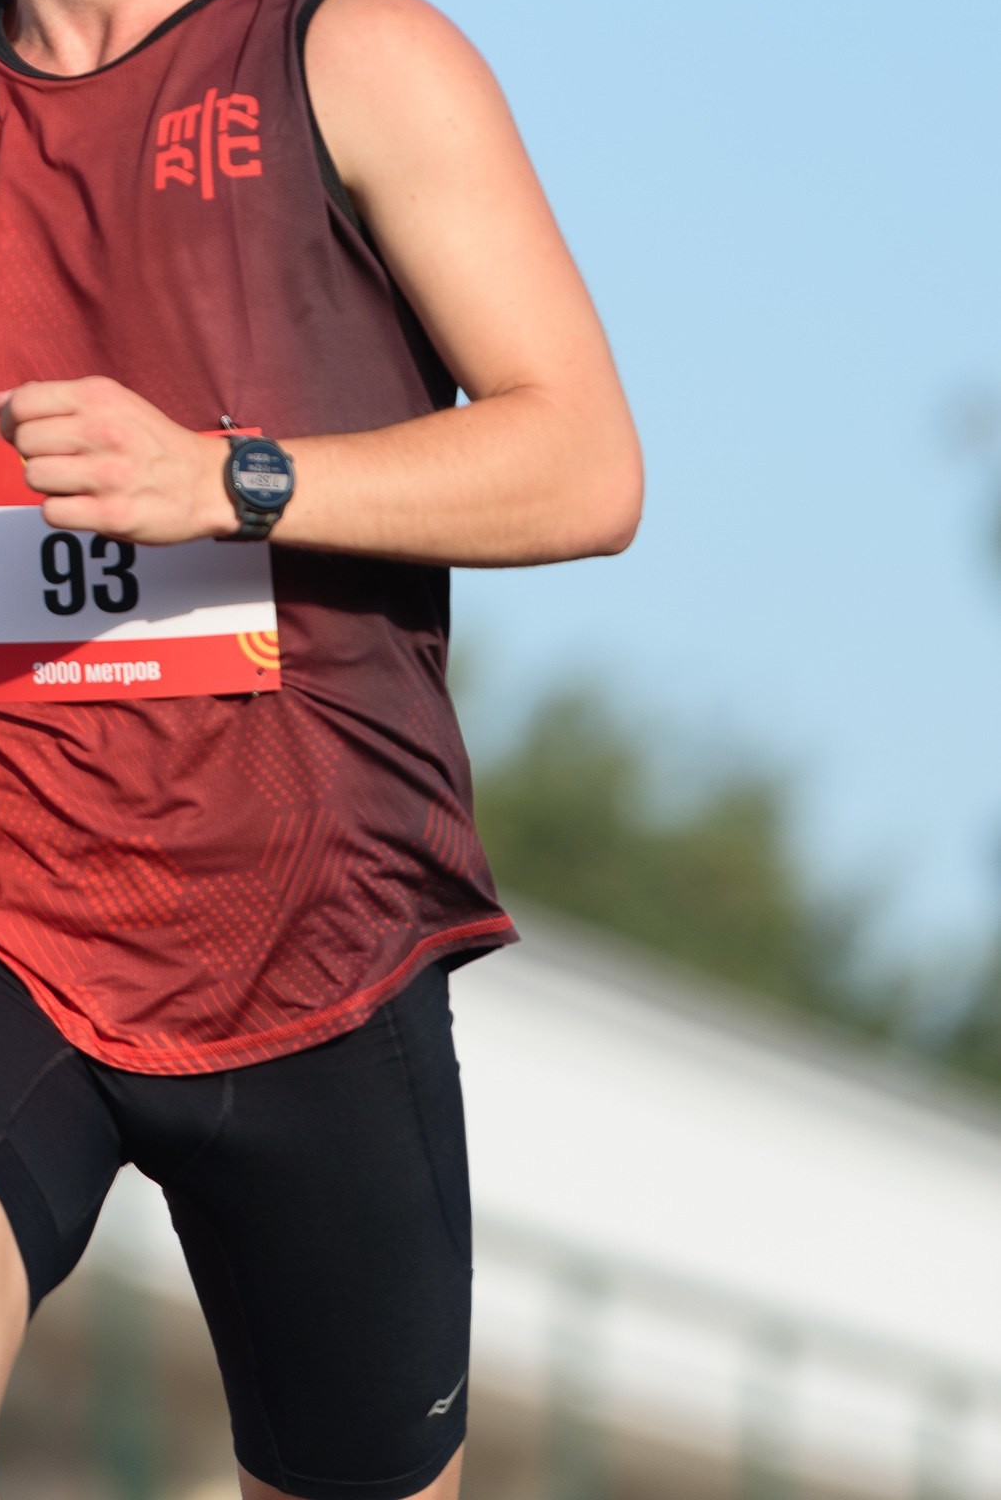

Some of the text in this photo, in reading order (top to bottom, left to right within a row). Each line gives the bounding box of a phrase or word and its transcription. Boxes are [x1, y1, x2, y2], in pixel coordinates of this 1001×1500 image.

[40, 532, 140, 617] 93
[32, 661, 161, 686] 3000 метров
